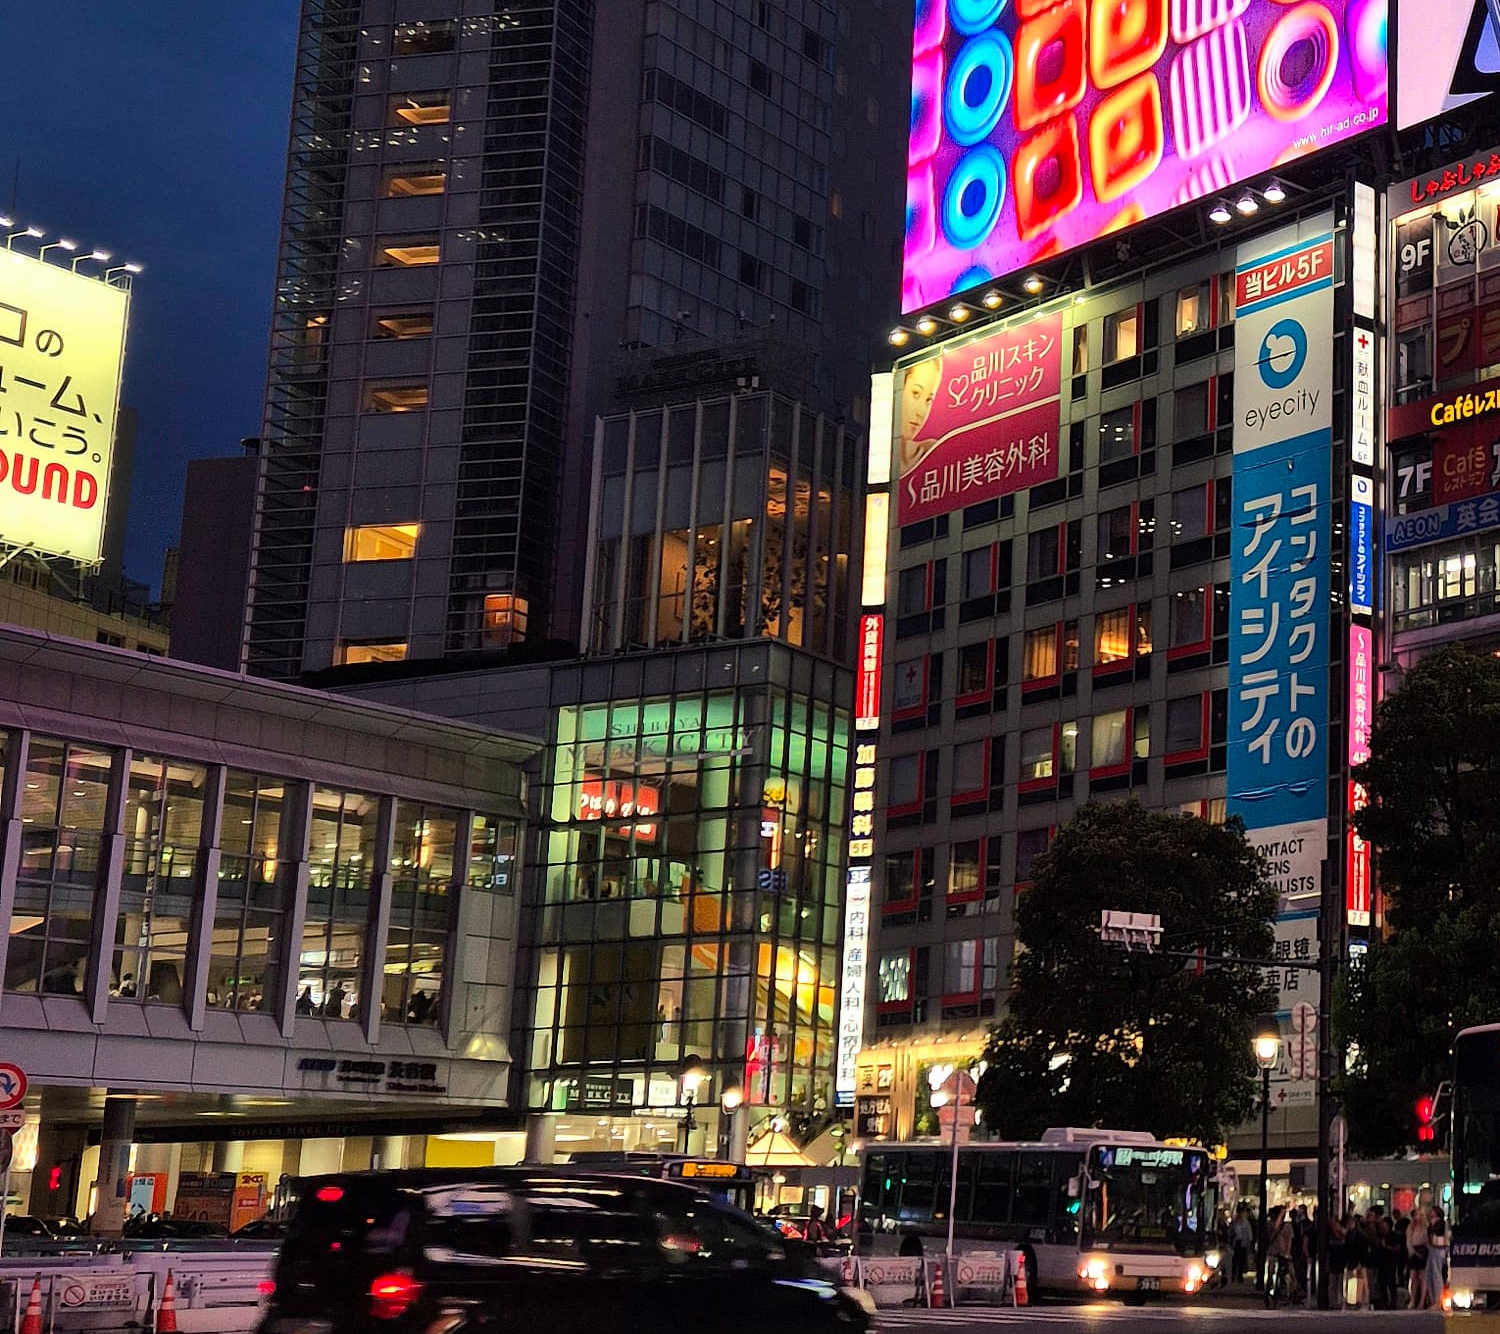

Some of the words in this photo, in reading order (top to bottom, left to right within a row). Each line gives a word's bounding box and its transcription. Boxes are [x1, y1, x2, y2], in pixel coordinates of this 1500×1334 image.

[1400, 239, 1431, 271] 9F
[1245, 249, 1324, 300] 当ビル5F
[970, 334, 1055, 384] 品川スキン
[969, 365, 1045, 413] クリニック
[1245, 389, 1321, 431] eyecity
[919, 431, 1052, 503] 品川美容外科
[1442, 445, 1487, 477] Café
[1397, 460, 1432, 497] 7F
[1443, 471, 1485, 492] レストラン
[1392, 514, 1443, 544] AEON
[1239, 492, 1283, 765] アイシティ
[1285, 482, 1318, 759] コンタクトの
[1354, 652, 1367, 744] 品川美容外科
[852, 843, 868, 854] 5F
[1256, 838, 1304, 857] ONTACT
[847, 910, 865, 940] 内科
[1351, 912, 1364, 923] 7F
[1264, 967, 1300, 991] 卖店
[878, 1068, 893, 1087] 2F
[1453, 1244, 1478, 1255] KEIO
